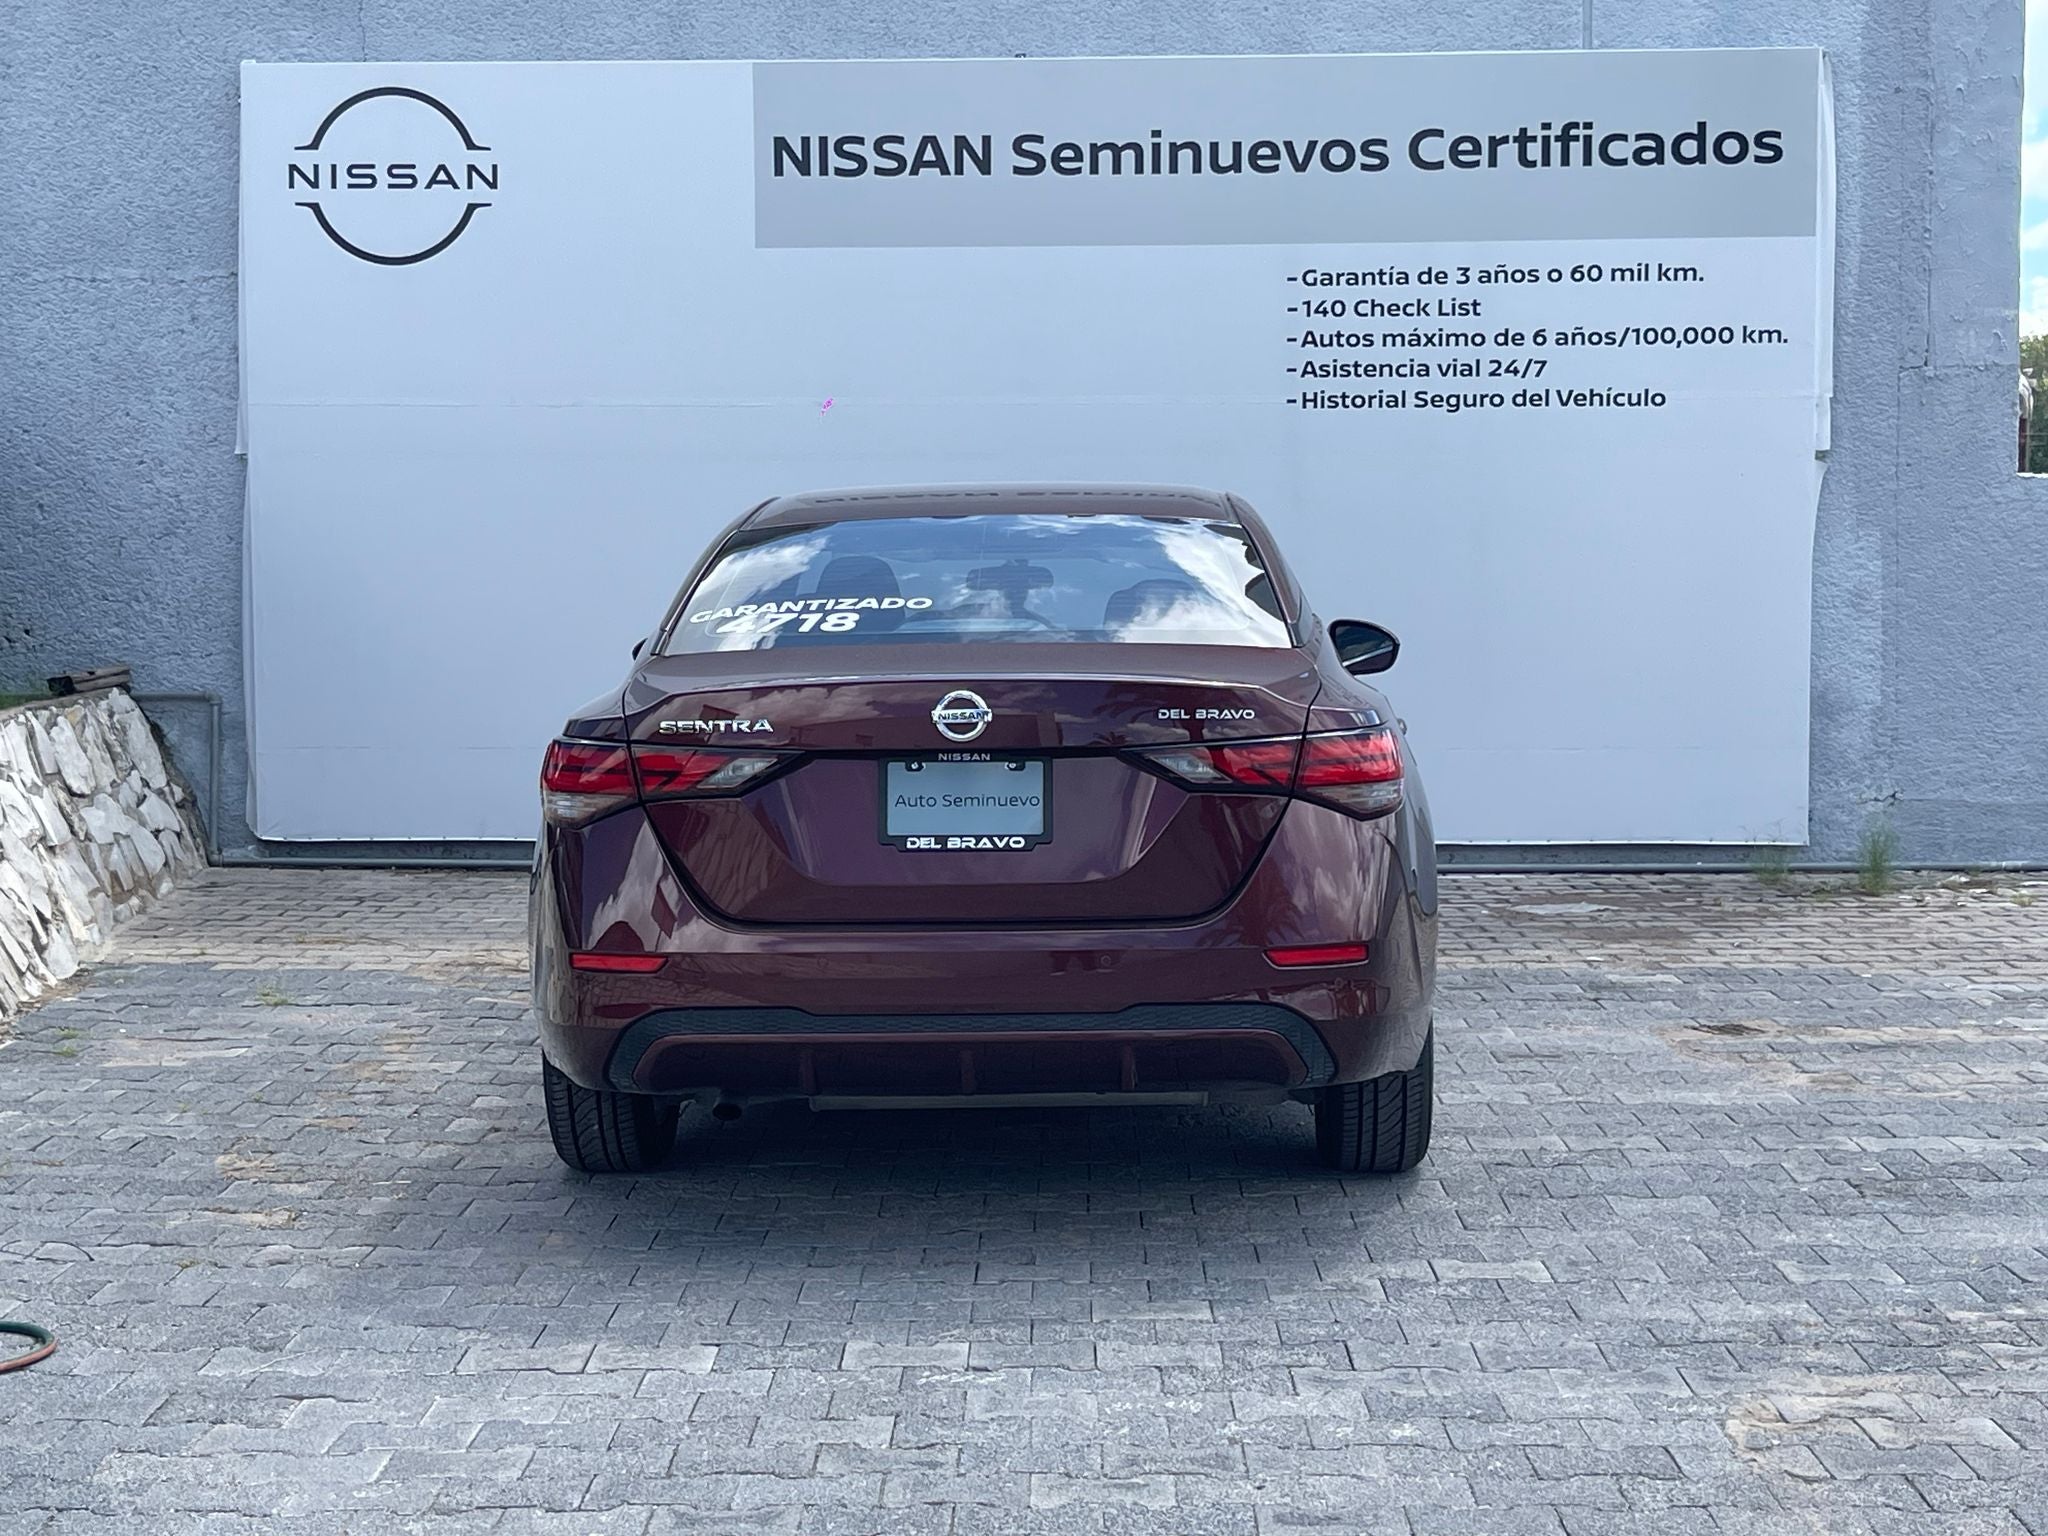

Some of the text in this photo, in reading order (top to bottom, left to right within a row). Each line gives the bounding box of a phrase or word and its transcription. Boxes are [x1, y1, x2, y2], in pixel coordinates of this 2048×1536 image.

[774, 121, 1784, 178] NISSAN Seminuevos Certificados
[288, 163, 498, 190] NISSAN
[1416, 266, 1449, 285] de
[1455, 266, 1471, 285] 3
[1477, 264, 1540, 285] años
[1547, 268, 1563, 283] o
[1570, 264, 1603, 283] 60
[1610, 262, 1650, 282] mil
[1657, 262, 1704, 282] km.
[1353, 298, 1431, 318] Check
[1437, 297, 1482, 317] List
[1381, 328, 1486, 348] máximo
[1493, 328, 1525, 347] de
[1532, 328, 1548, 347] 6
[1554, 326, 1735, 349] años/100,000
[1742, 325, 1788, 344] km.
[1436, 358, 1481, 378] vial
[1487, 358, 1548, 379] 24/7
[1413, 390, 1505, 414] Seguro
[1511, 388, 1550, 408] del
[1555, 386, 1666, 407] Vehículo
[689, 597, 933, 624] GARANTIZADO
[716, 612, 861, 634] 4718
[938, 710, 986, 721] NISSAN
[1157, 708, 1255, 720] DEL BRAVO
[659, 719, 774, 734] SENTRA
[937, 753, 991, 761] NISSAN
[894, 794, 1041, 808] Auto Seminuevo
[906, 836, 1026, 849] DEL BRAVO
